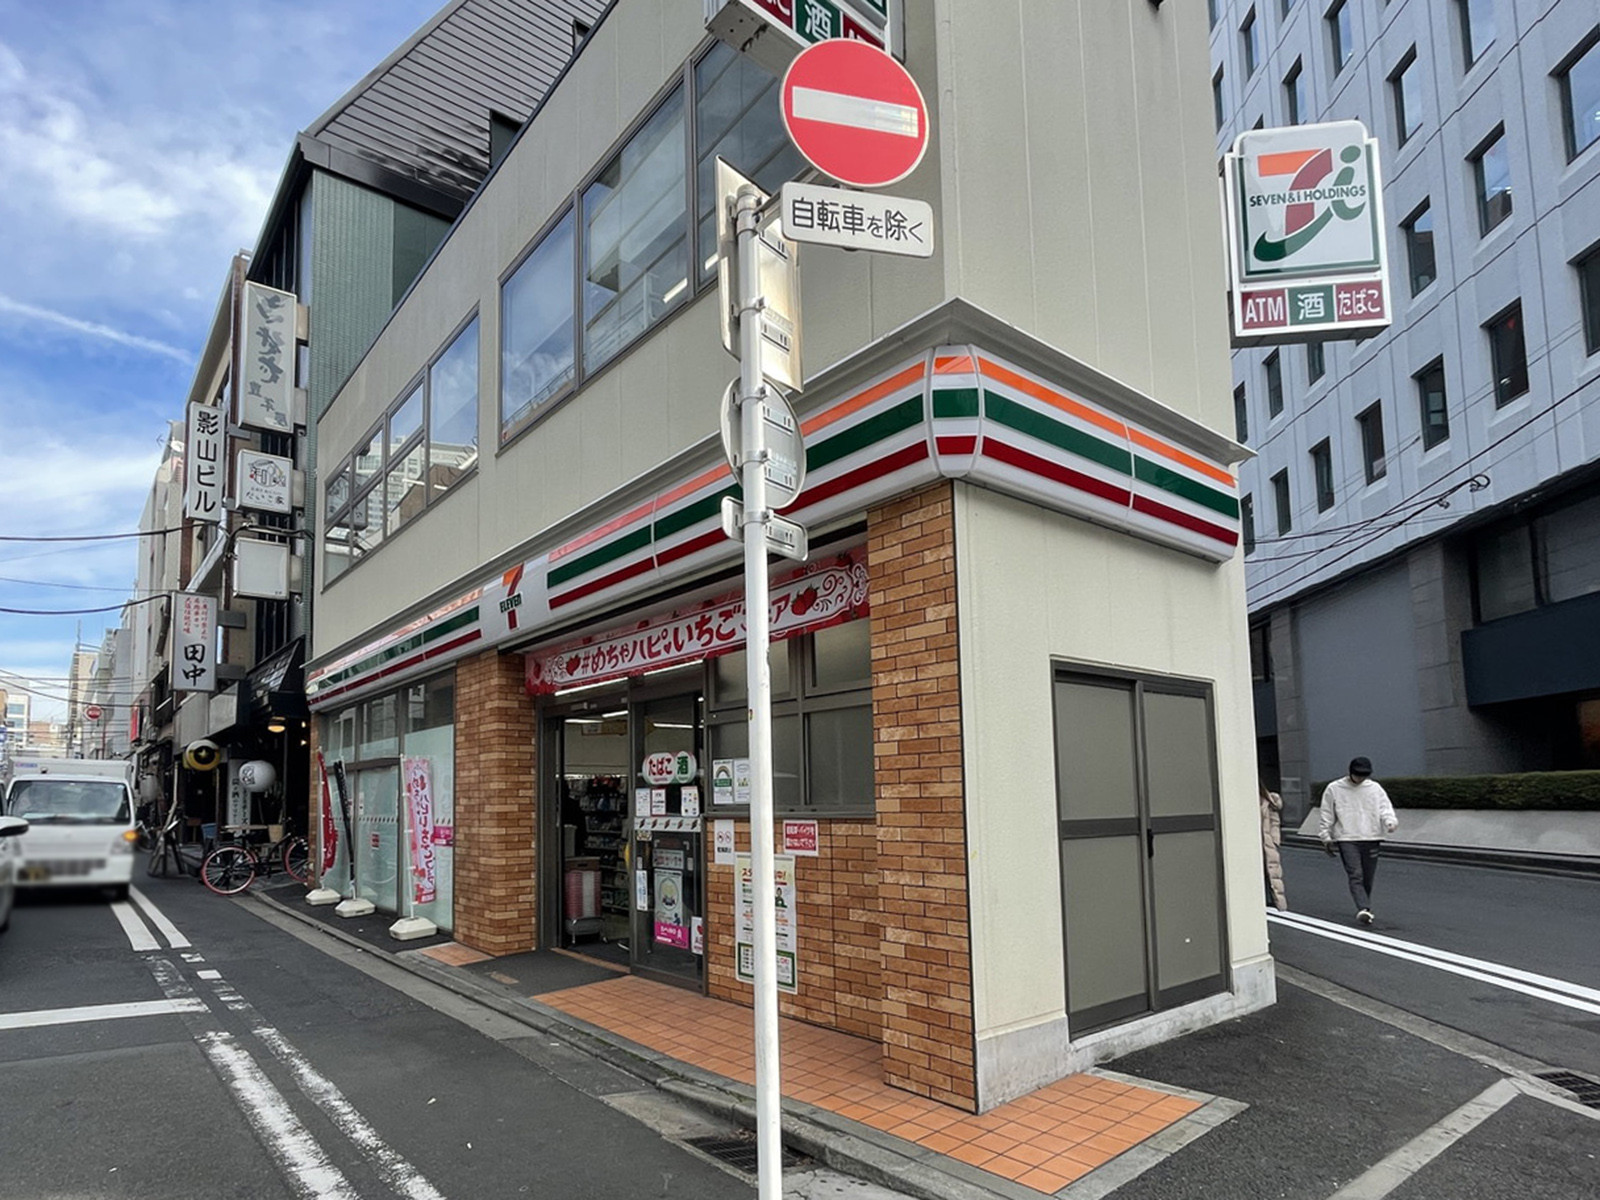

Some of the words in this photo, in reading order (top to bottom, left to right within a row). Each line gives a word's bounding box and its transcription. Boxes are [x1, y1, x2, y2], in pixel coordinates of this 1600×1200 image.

[1303, 184, 1366, 201] HOLDINGS
[792, 197, 924, 244] 自転車を除く
[1245, 297, 1284, 323] ATM
[1297, 292, 1325, 320] 酒
[1338, 288, 1381, 316] たばこ
[195, 410, 219, 513] 影山ビル
[181, 643, 207, 687] 田中
[648, 757, 673, 776] たばこ
[677, 755, 689, 775] 酒
